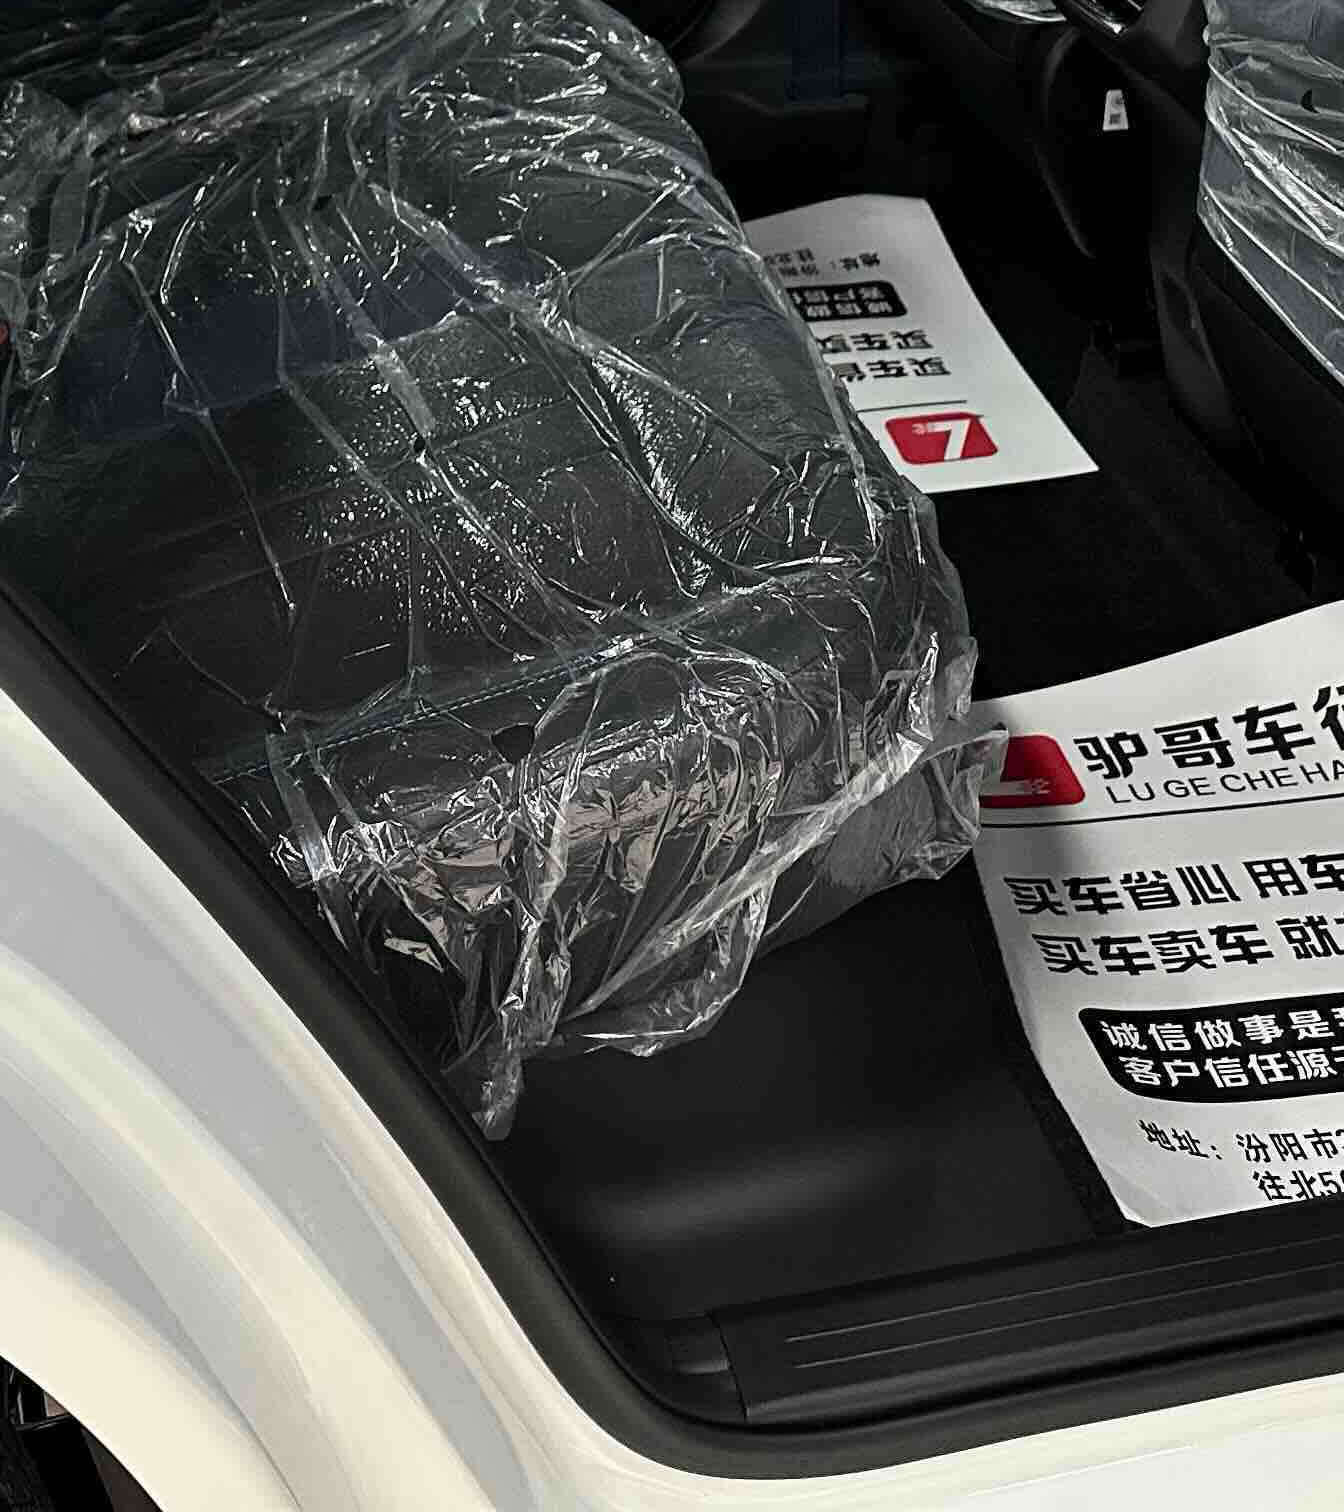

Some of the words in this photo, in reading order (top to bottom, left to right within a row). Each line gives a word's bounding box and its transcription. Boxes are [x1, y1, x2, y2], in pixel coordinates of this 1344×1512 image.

[1105, 782, 1156, 804] LU
[1162, 776, 1217, 798] GE
[1219, 767, 1295, 792] CHE
[1003, 864, 1240, 916] 买车省心
[1031, 924, 1276, 977] 买车卖车
